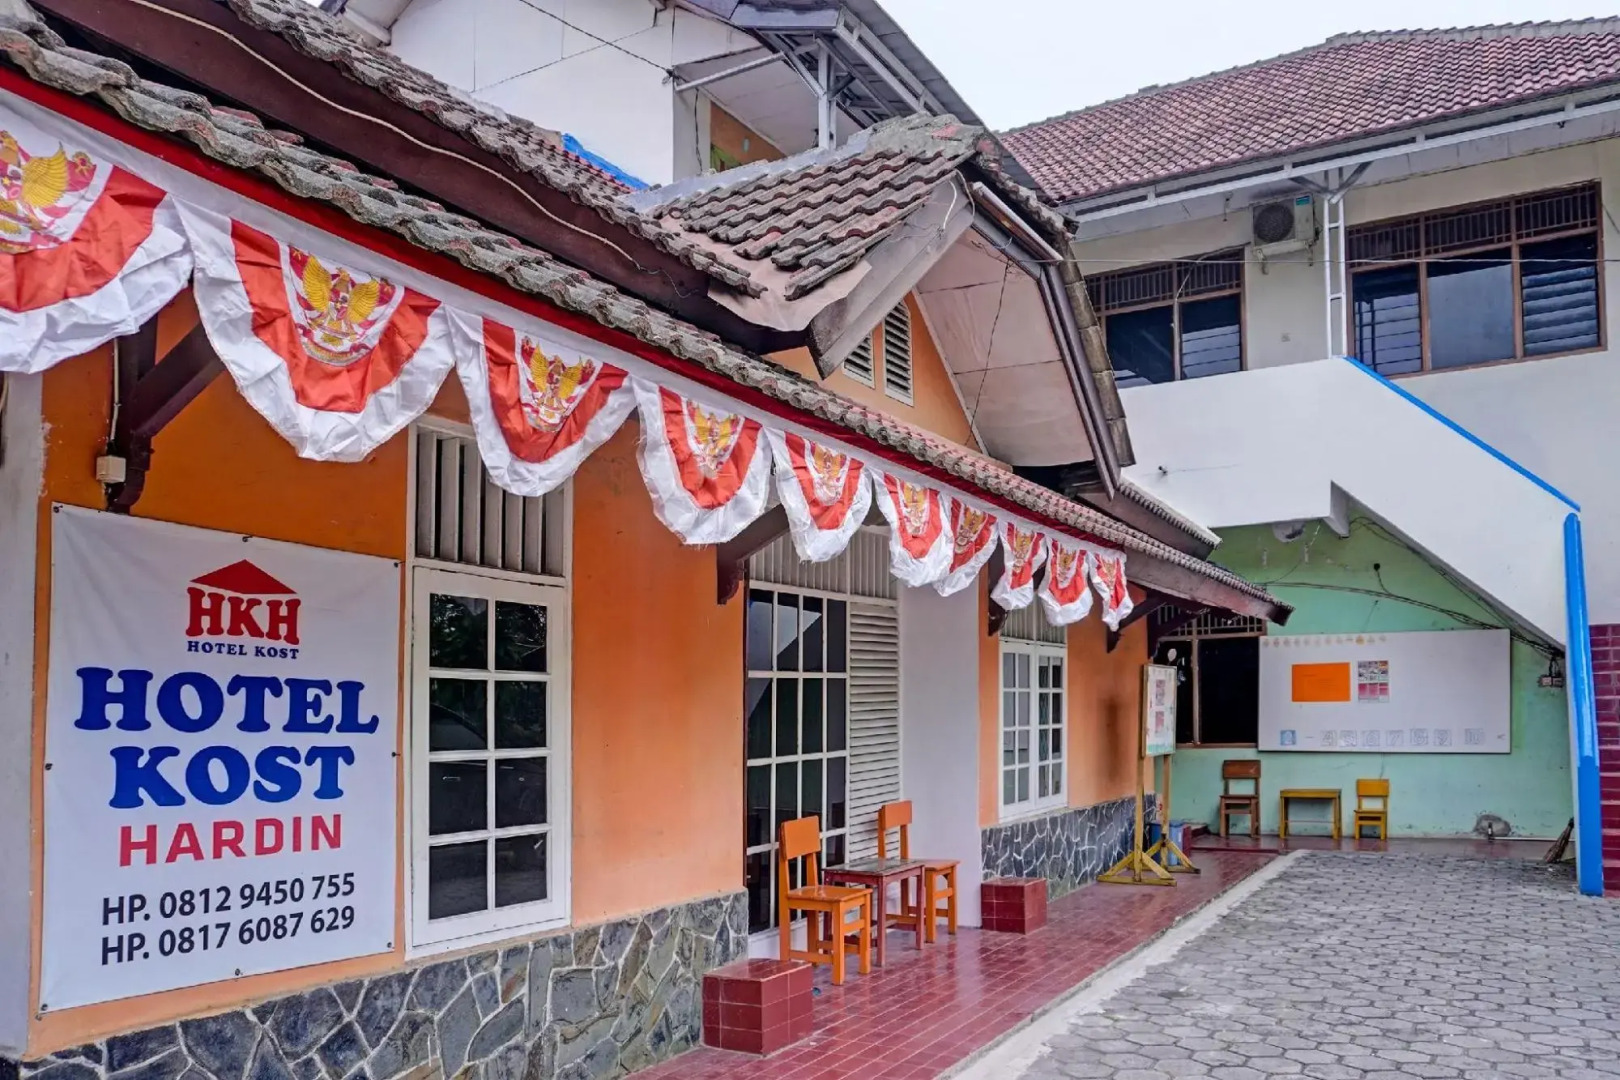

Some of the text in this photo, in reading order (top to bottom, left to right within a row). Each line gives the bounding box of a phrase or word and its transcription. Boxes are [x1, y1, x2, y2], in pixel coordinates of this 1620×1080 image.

[186, 586, 301, 645] HKH
[187, 640, 300, 660] HOTEL KOST
[74, 667, 379, 734] HOTEL
[108, 745, 355, 810] KOST
[119, 814, 342, 867] HARDIN
[102, 872, 355, 926] HP. 0812 9450 755
[101, 905, 355, 966] HP. 0817 6087 629
